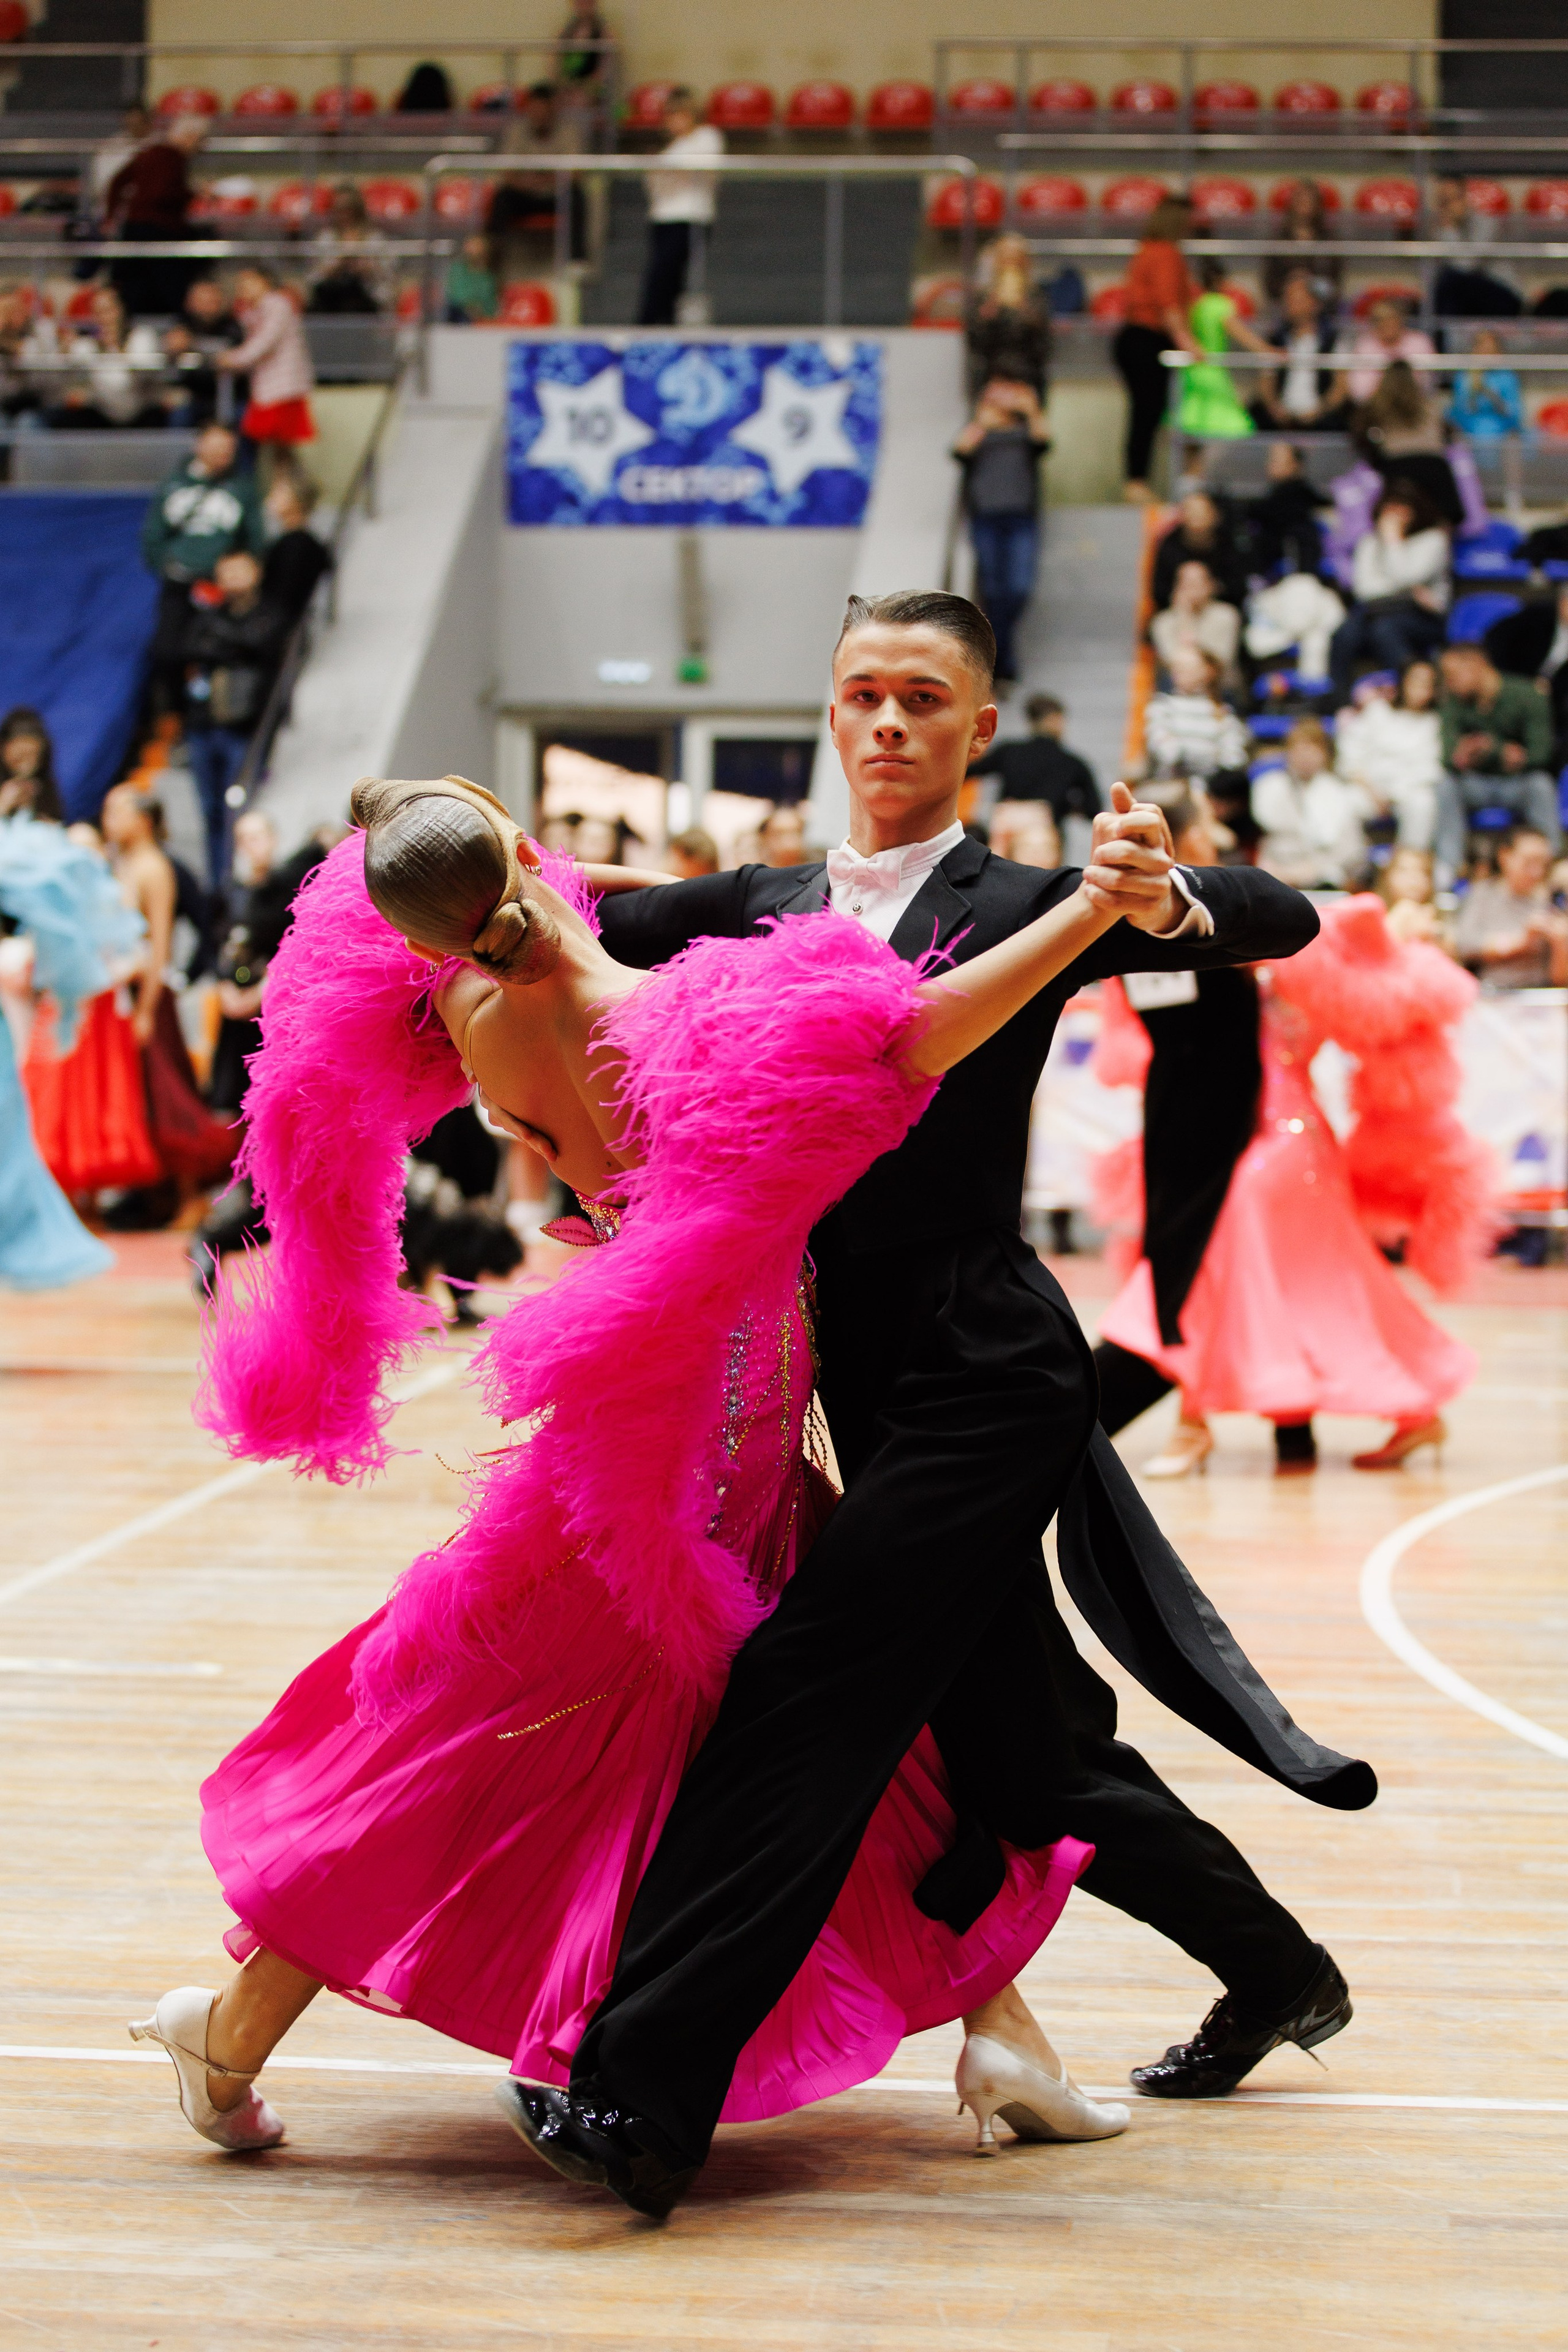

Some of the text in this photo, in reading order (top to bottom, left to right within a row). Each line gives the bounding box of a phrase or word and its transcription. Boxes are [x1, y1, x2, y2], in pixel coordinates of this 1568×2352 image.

[565, 404, 616, 450] 10
[780, 403, 813, 450] 9
[619, 464, 766, 505] СЕКТОР
